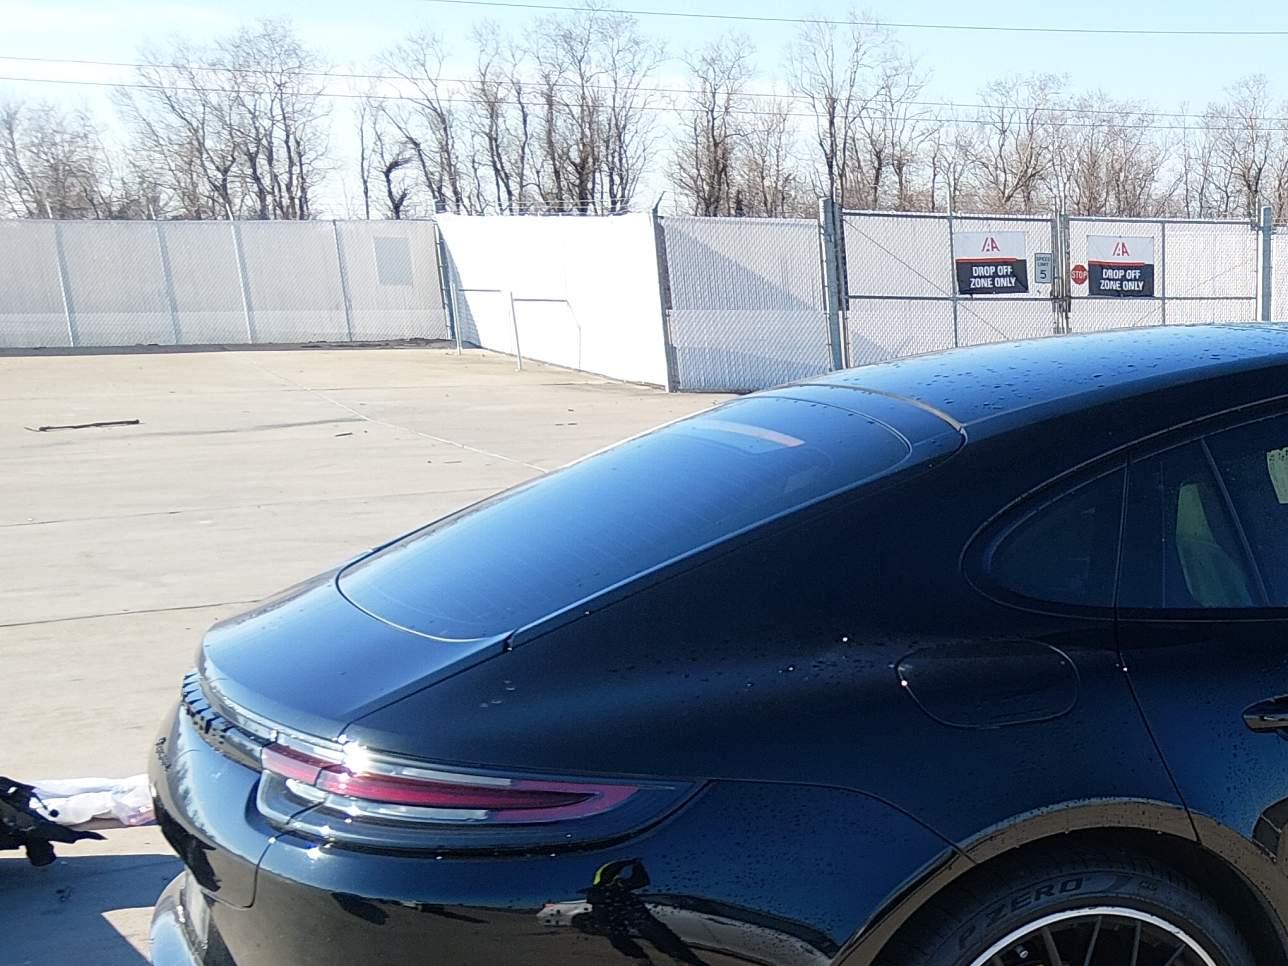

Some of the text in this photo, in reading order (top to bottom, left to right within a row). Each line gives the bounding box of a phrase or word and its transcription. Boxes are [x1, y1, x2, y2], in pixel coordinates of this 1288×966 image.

[972, 265, 1013, 277] DROP OFF
[1040, 269, 1047, 280] 5
[1071, 270, 1088, 279] STOP
[1102, 269, 1141, 280] DROP OFF
[969, 276, 1017, 289] ZONE ONLY
[1099, 280, 1144, 291] ZONE ONLY
[985, 877, 1084, 928] ZERO
